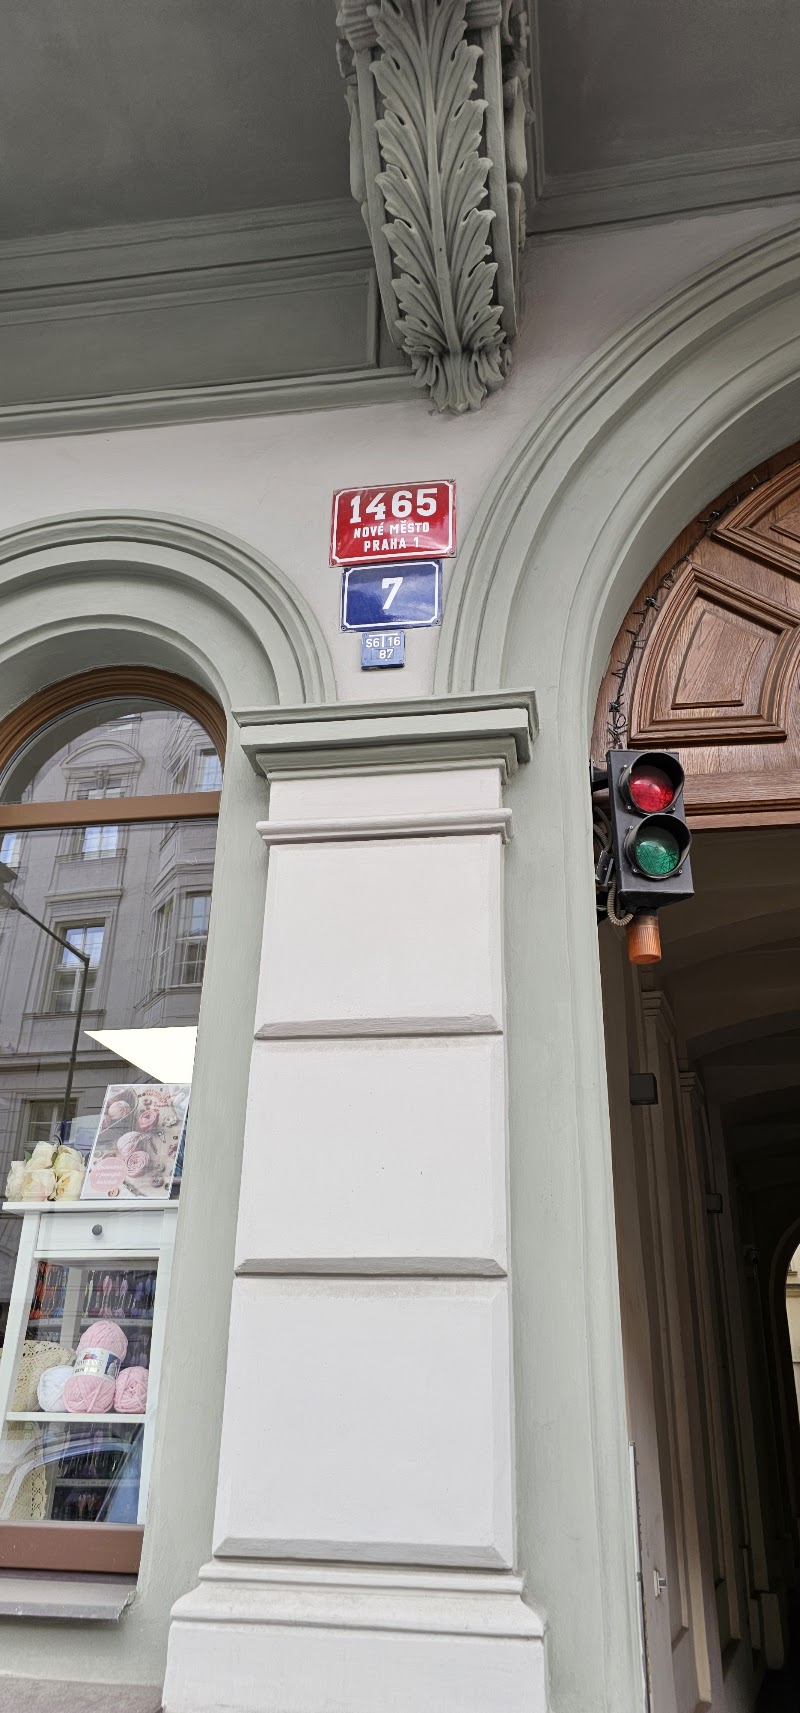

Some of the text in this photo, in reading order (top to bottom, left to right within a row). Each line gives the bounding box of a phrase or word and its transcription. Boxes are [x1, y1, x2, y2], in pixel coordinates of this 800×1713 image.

[350, 488, 438, 524] 1465
[354, 520, 430, 539] NOVÉ MĚSTO
[364, 536, 419, 552] PRAHA 1
[381, 577, 404, 610] 7
[388, 636, 401, 647] 16
[379, 648, 394, 659] 87
